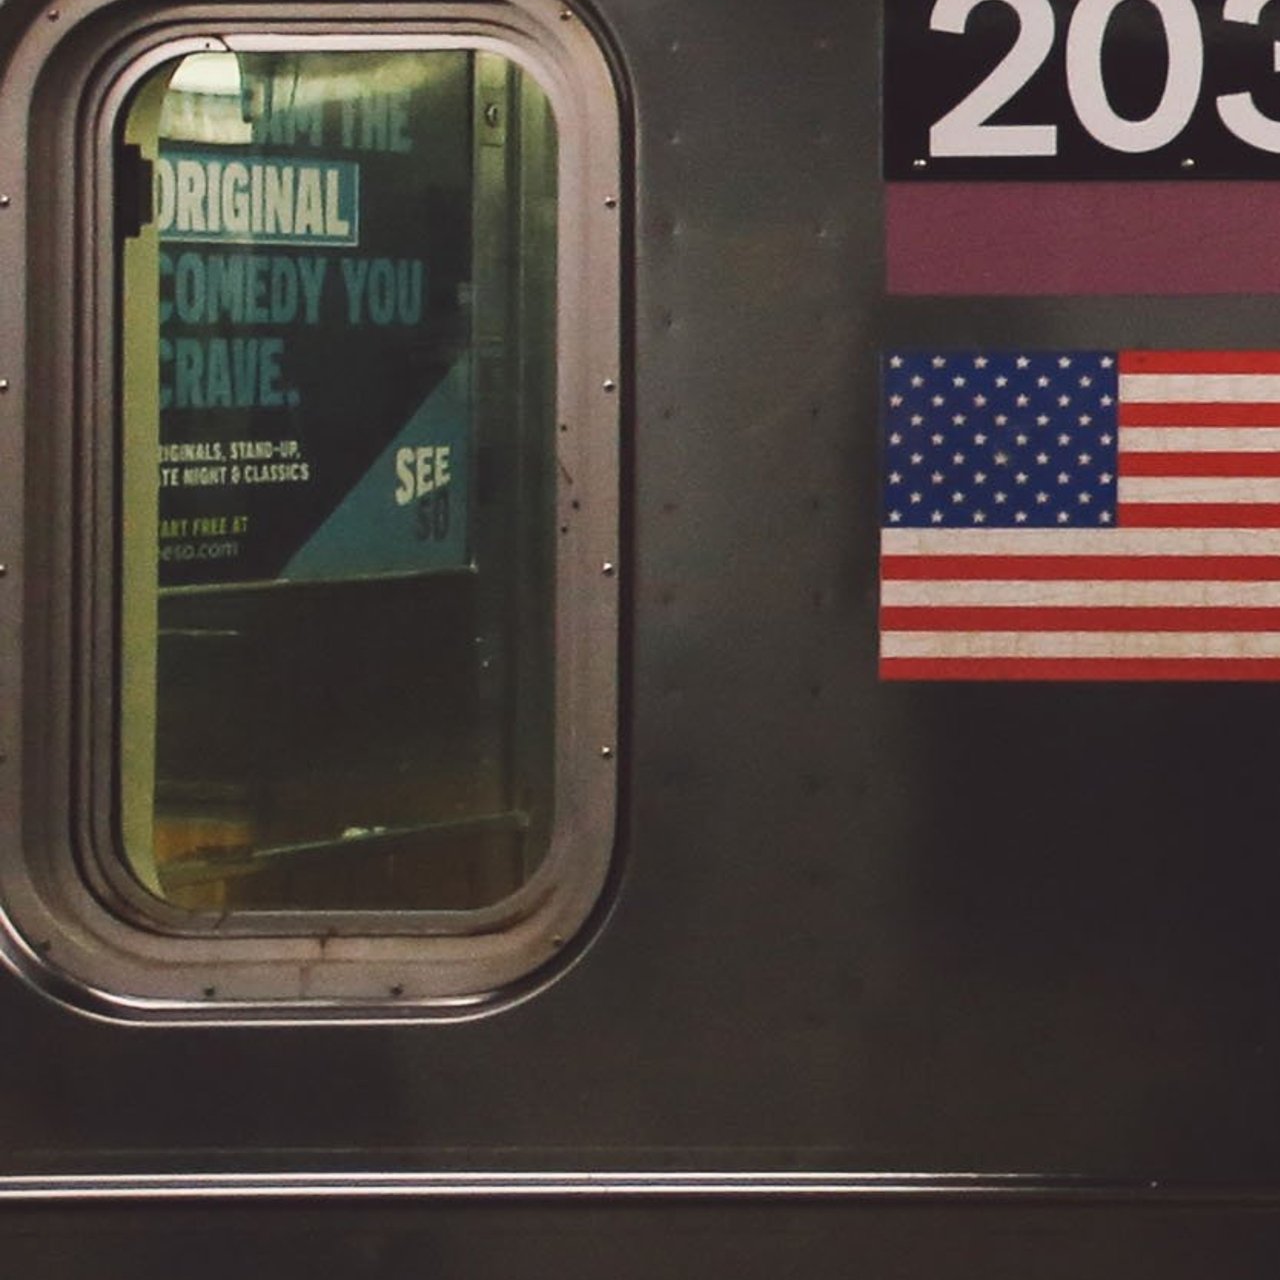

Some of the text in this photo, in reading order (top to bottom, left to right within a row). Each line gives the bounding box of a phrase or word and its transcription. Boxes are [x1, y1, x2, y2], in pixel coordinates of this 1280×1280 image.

[154, 158, 350, 236] ORIGINAL
[340, 257, 423, 325] YOU
[183, 466, 227, 485] NIGHT
[244, 462, 310, 483] CLASSICS
[229, 440, 301, 460] STAND-UP,
[395, 446, 451, 506] SEE
